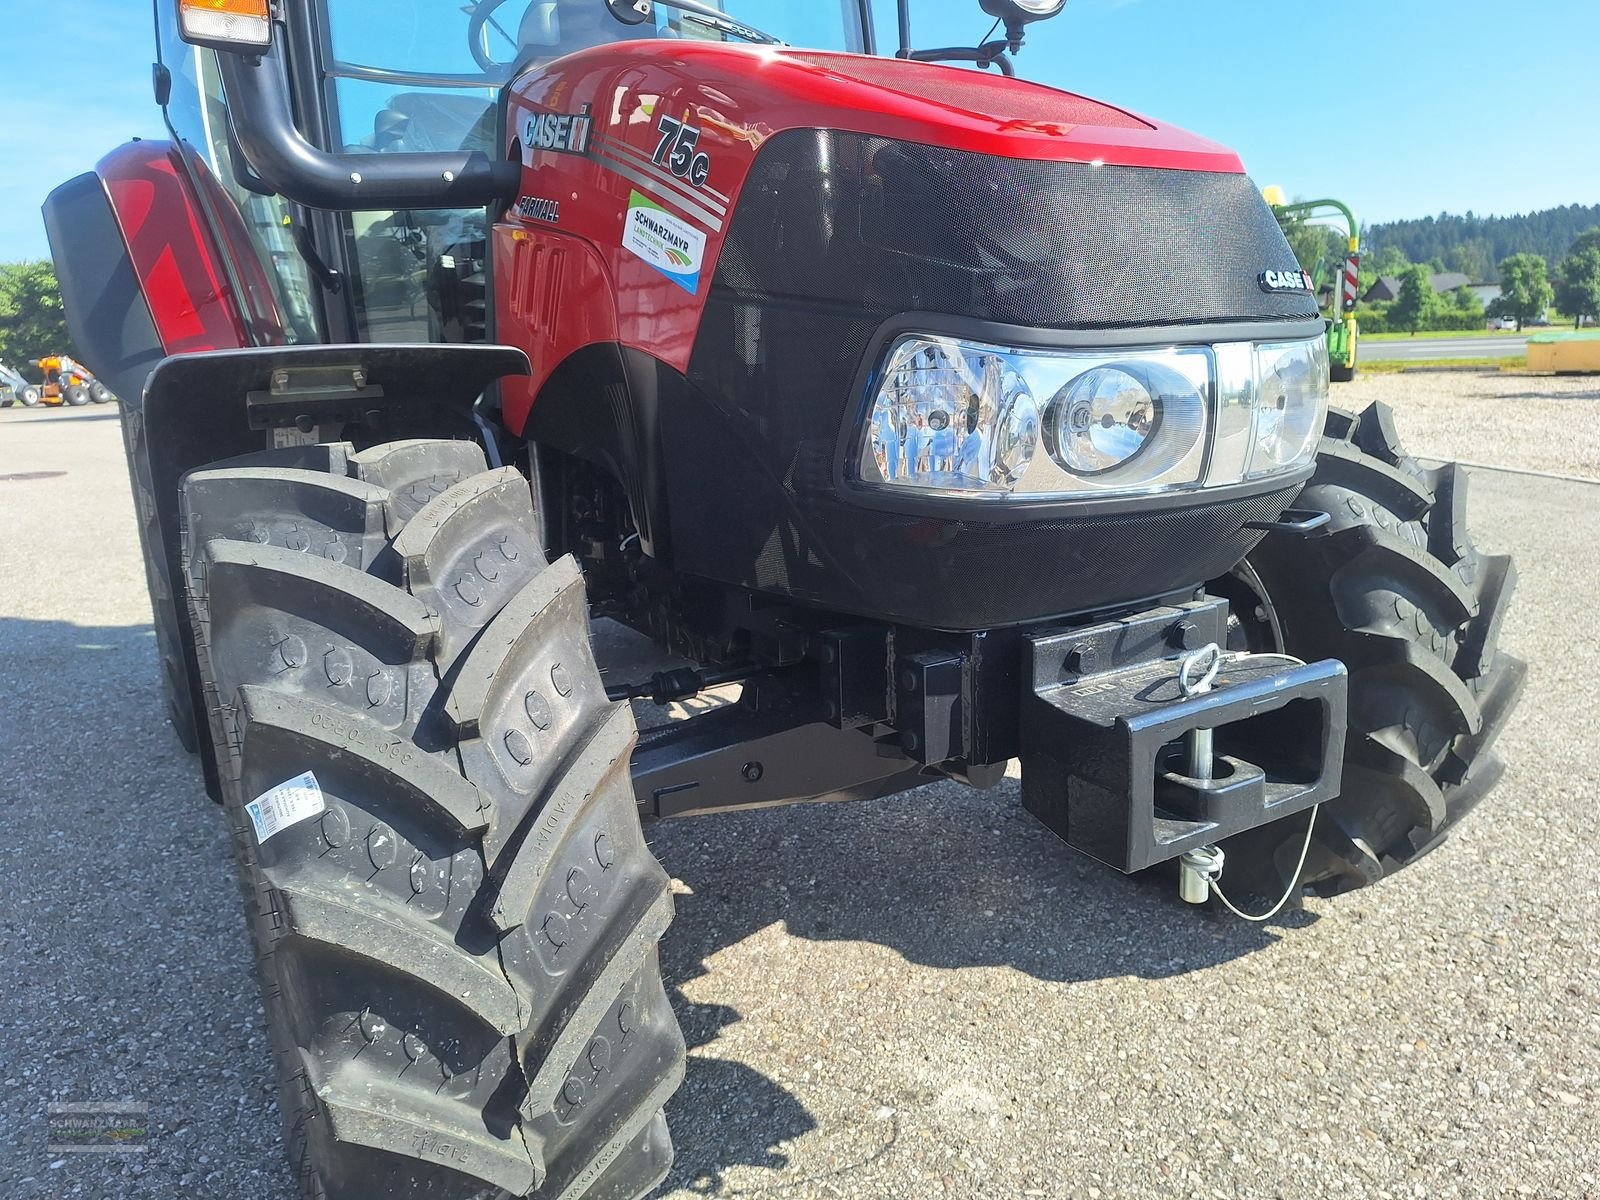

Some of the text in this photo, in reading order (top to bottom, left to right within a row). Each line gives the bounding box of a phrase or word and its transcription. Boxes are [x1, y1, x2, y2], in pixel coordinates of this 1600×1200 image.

[523, 112, 569, 150] CASE
[520, 196, 560, 223] FARMALL
[634, 210, 689, 254] SCHWARZMAYR
[1265, 269, 1304, 289] CASE
